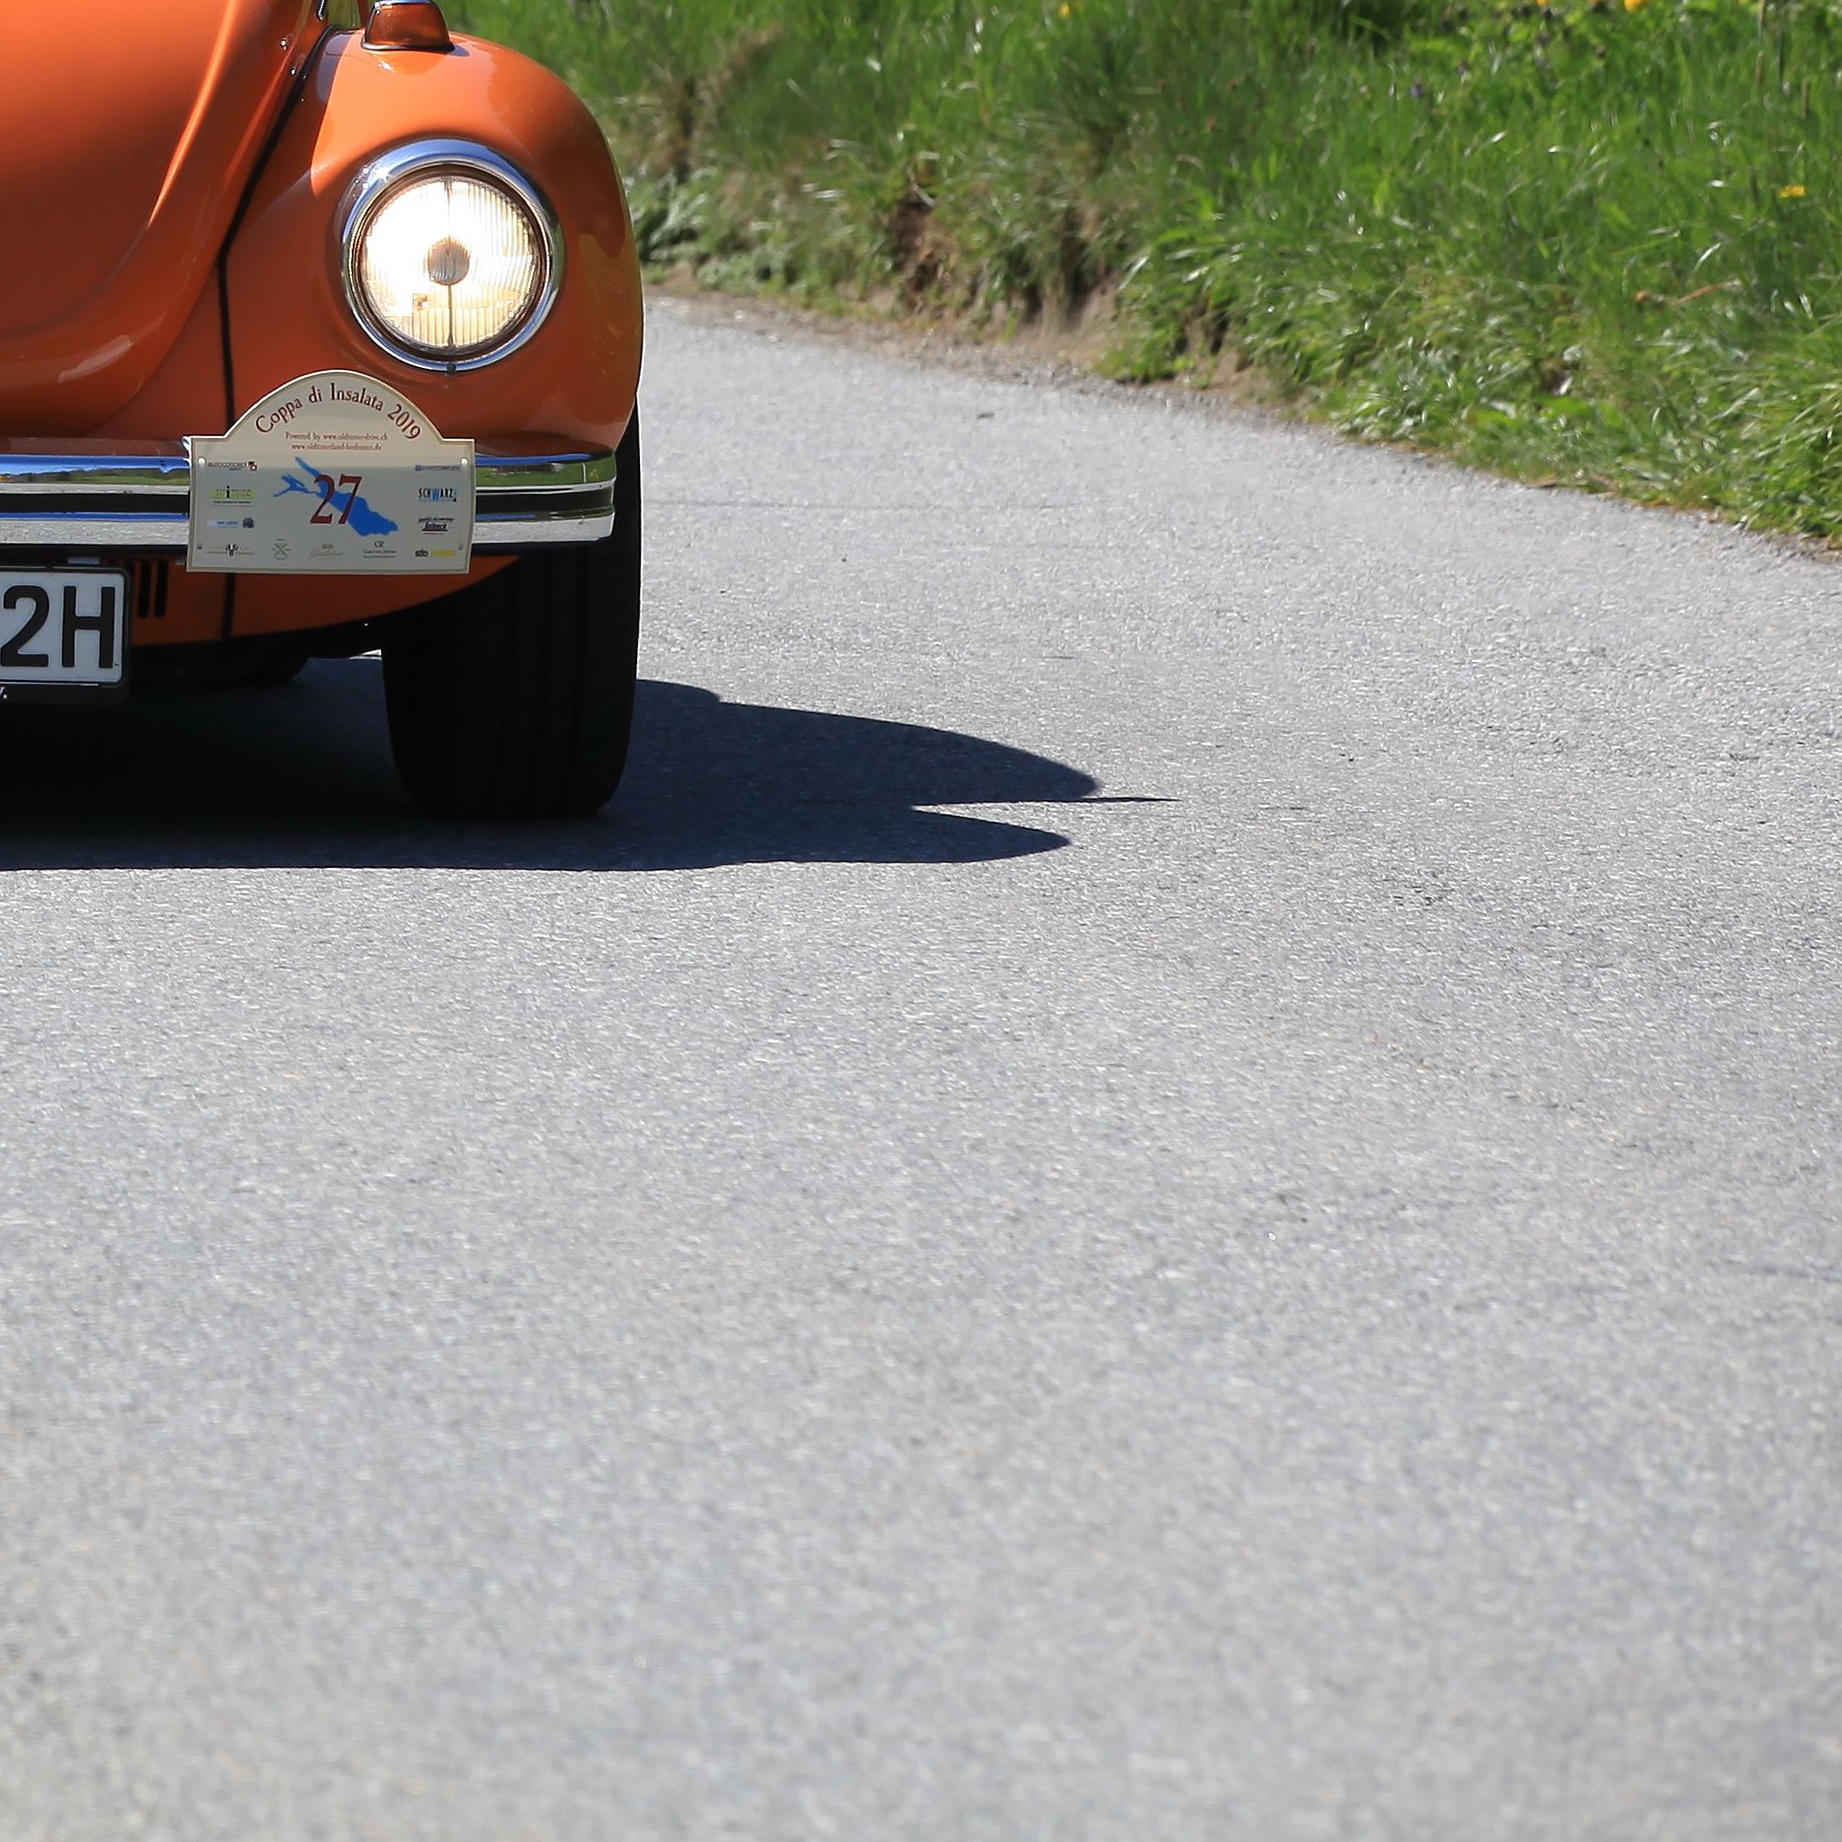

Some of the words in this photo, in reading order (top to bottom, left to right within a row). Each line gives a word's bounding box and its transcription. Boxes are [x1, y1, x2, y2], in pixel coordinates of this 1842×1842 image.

[255, 398, 303, 433] Coppa
[308, 385, 323, 404] di
[330, 382, 384, 411] Insalata
[387, 404, 421, 439] 2019
[309, 473, 363, 525] 27
